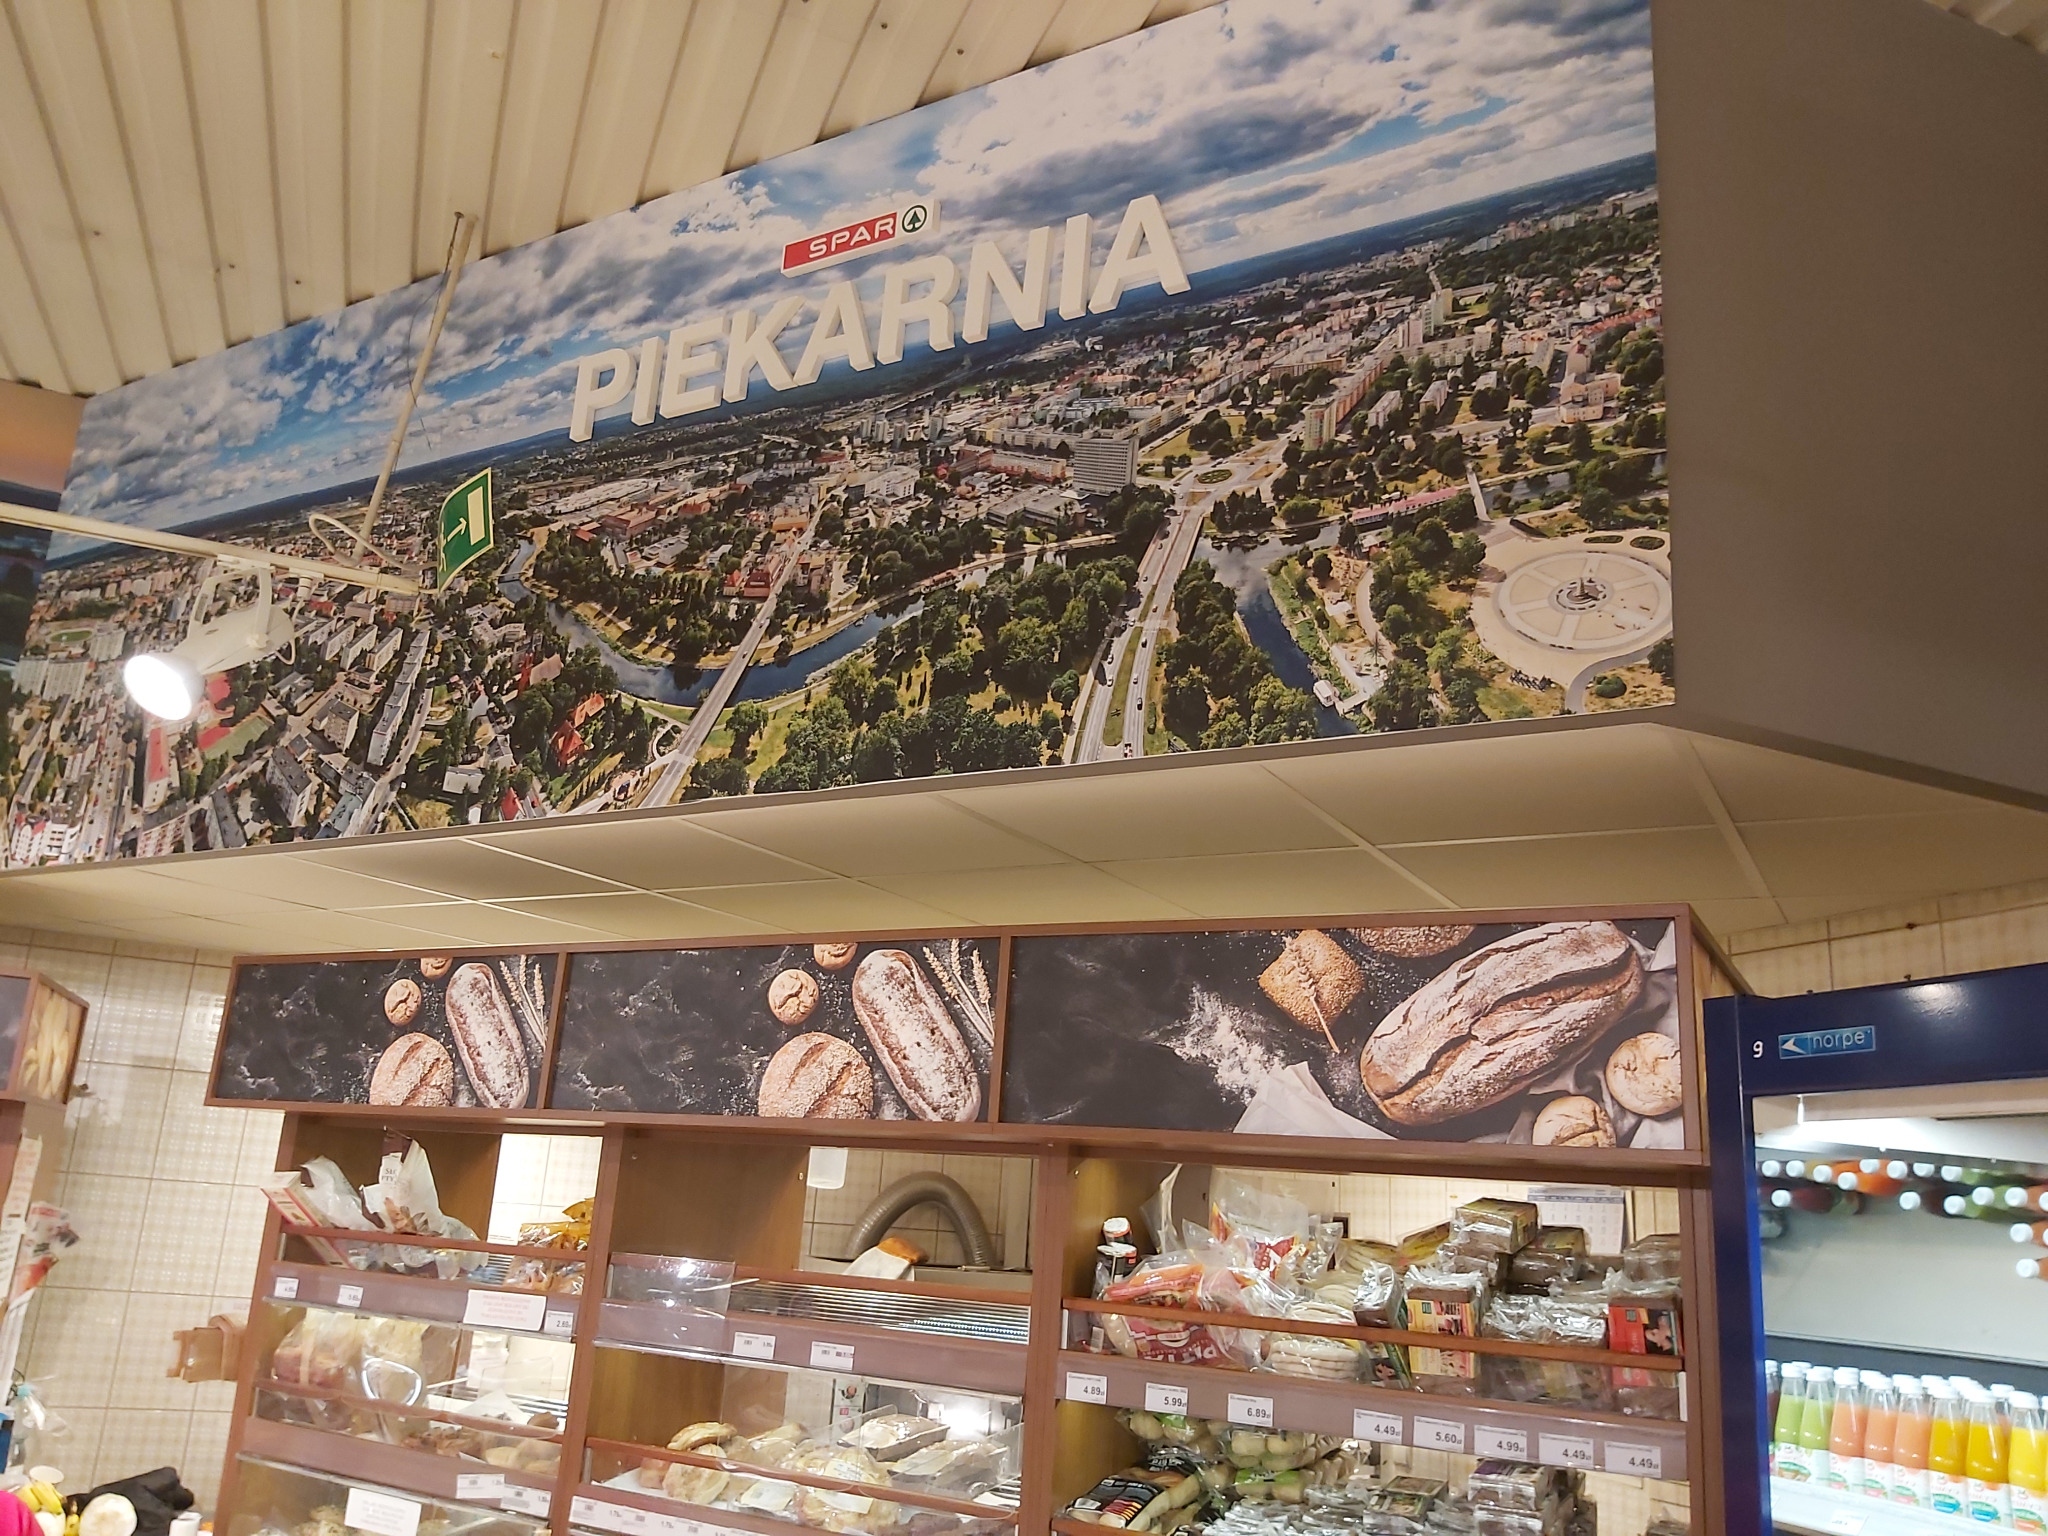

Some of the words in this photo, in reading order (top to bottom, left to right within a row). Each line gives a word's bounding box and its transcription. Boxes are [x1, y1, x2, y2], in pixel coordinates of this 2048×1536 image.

[807, 216, 897, 260] SPAR
[568, 193, 1192, 444] PIEKARNIA
[1812, 1031, 1865, 1049] norpe
